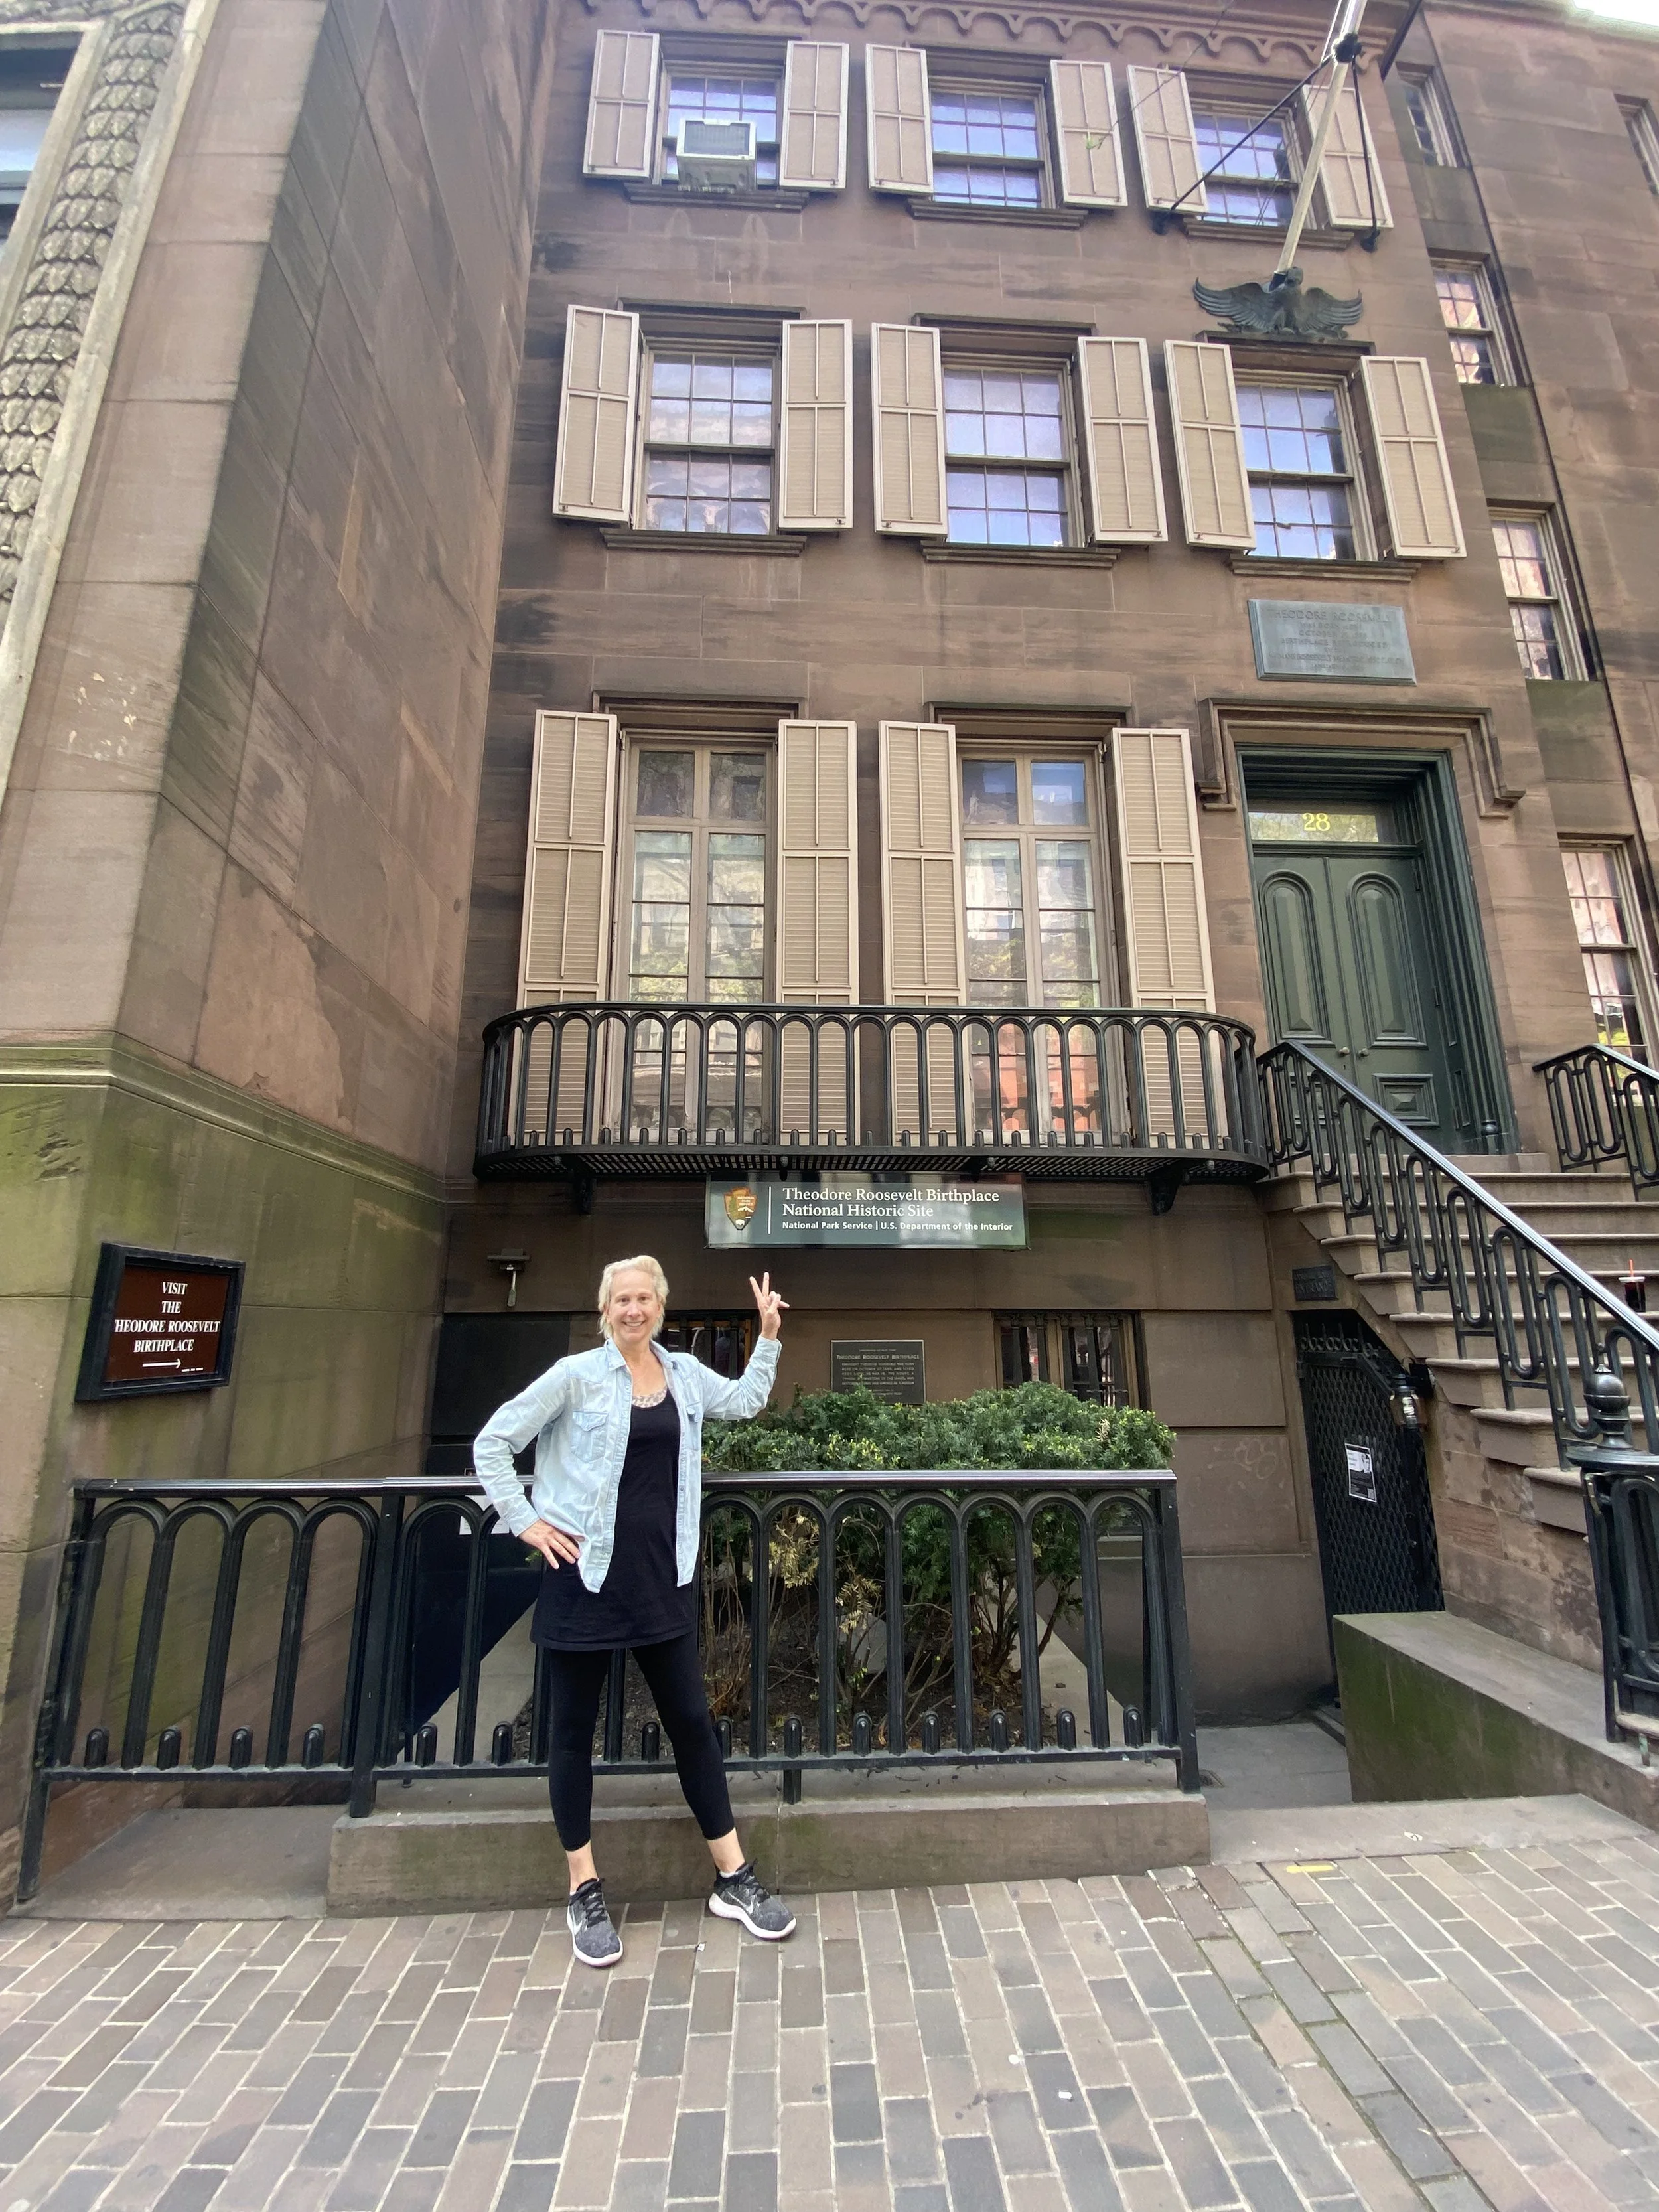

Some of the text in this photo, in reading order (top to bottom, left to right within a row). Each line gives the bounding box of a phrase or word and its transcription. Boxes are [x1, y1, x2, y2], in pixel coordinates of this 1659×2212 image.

[1302, 812, 1331, 832] 28
[782, 1187, 999, 1205] Theodore Roosevelt Birthplace
[782, 1203, 934, 1217] National Historic Site
[900, 1222, 950, 1232] Department
[162, 1282, 188, 1295] VISIT
[161, 1301, 182, 1313] THE
[114, 1319, 220, 1333] HEODORE ROOSEVELT
[133, 1339, 194, 1353] BIRTHPLACE
